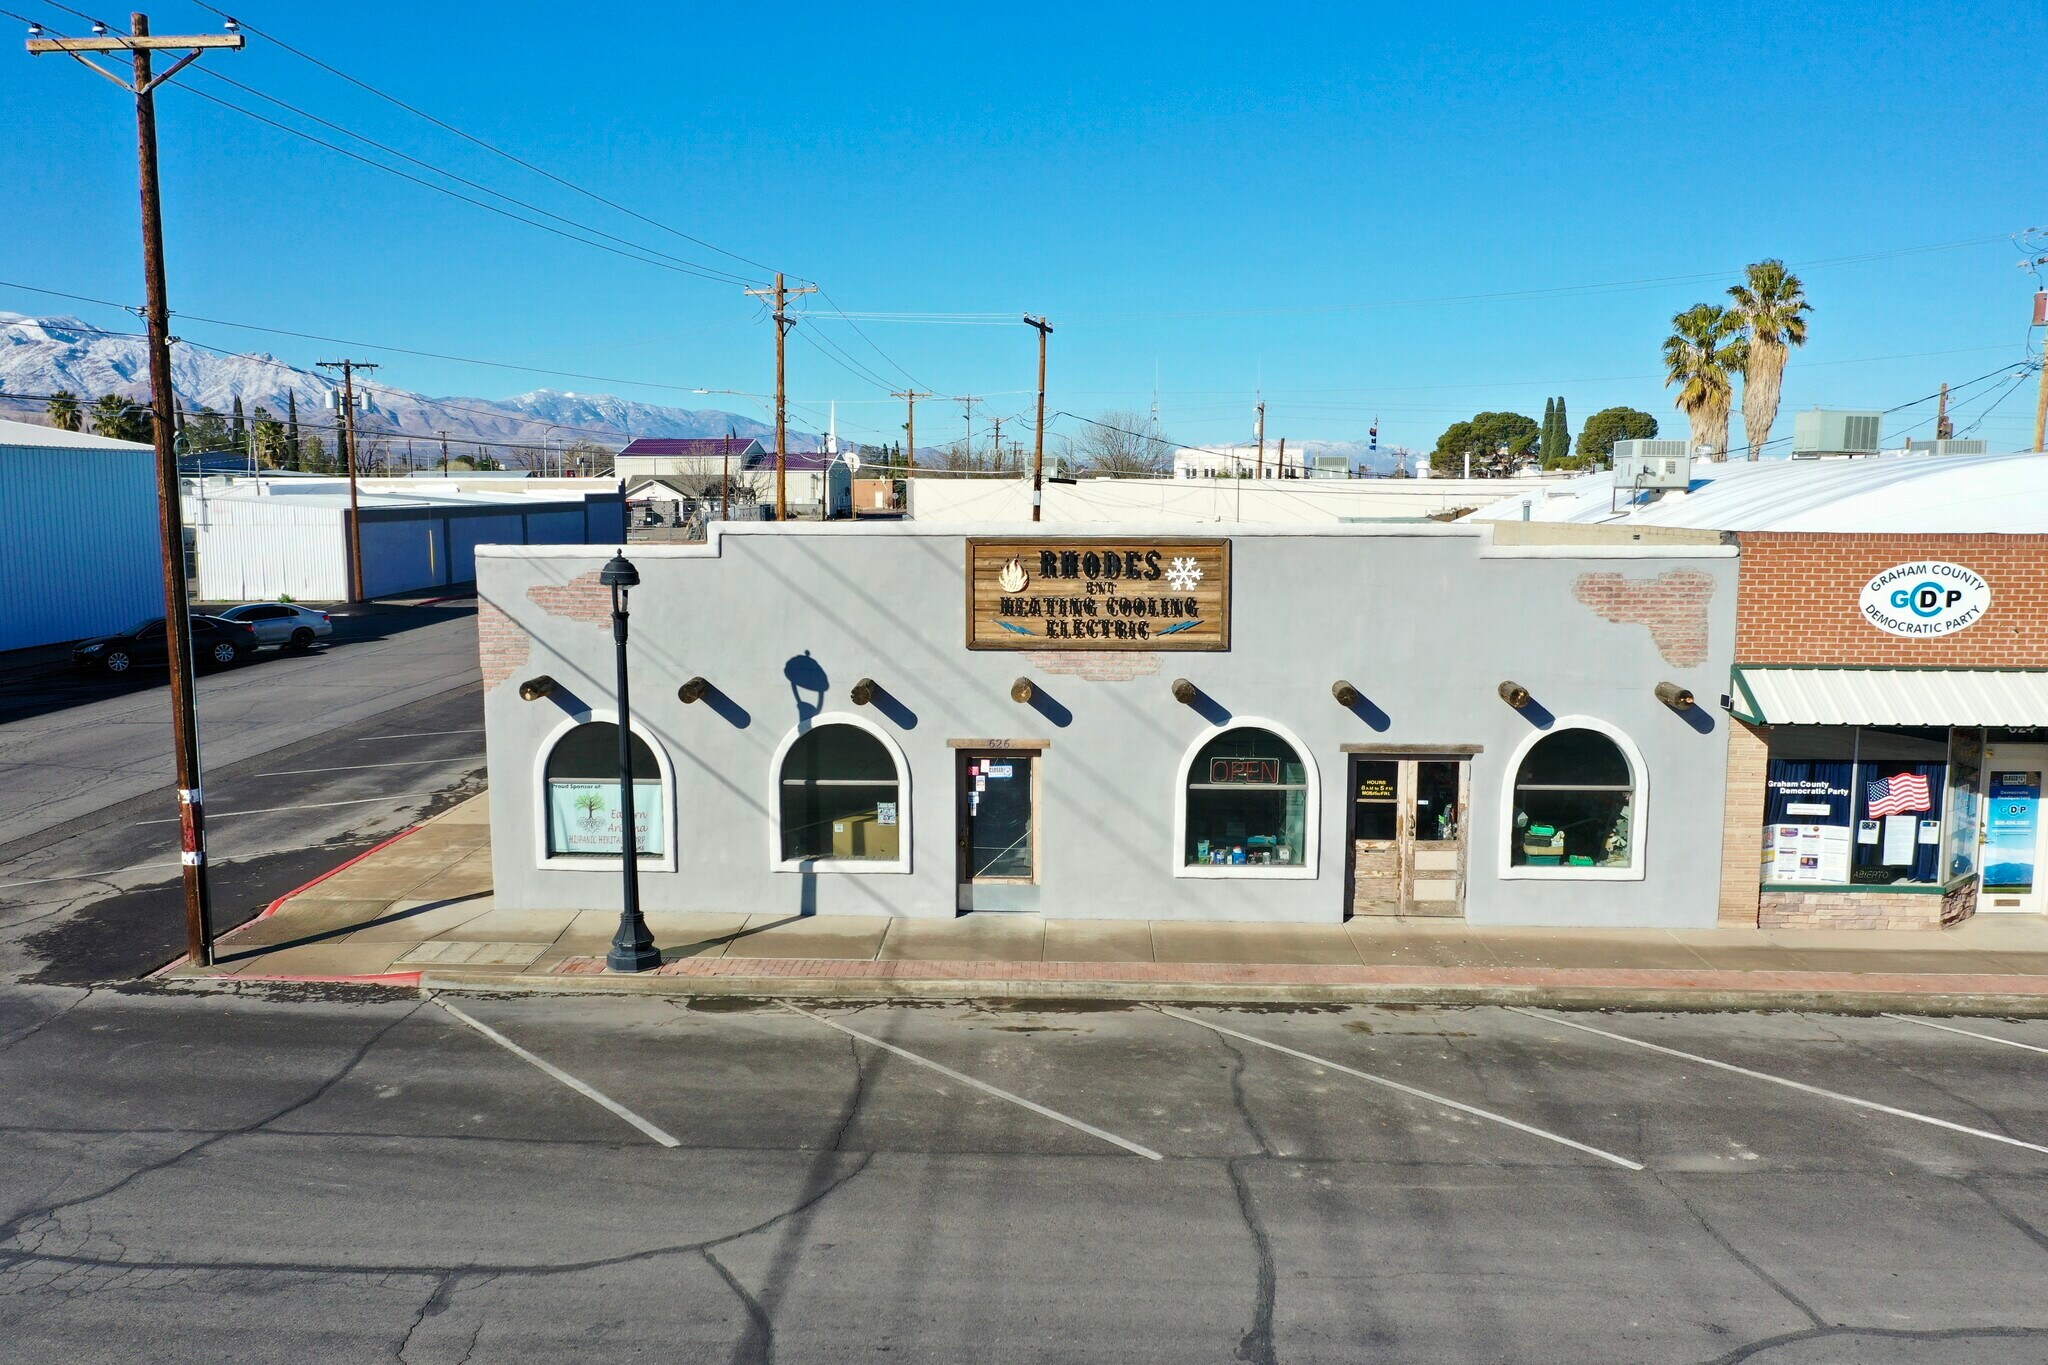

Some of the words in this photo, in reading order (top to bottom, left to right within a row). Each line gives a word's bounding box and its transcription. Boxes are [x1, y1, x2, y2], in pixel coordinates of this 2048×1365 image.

[1038, 549, 1162, 581] RHODES
[1871, 564, 1927, 592] GRAHAM
[1931, 564, 1985, 592] COUNTY
[999, 596, 1098, 618] HEATING
[1105, 596, 1199, 618] COOLING
[1865, 604, 1943, 634] DEMOCRATIC
[1945, 604, 1981, 631] PARTY
[1045, 619, 1151, 641] ELECTRIC
[988, 739, 1011, 749] 626
[1212, 760, 1277, 783] OPEN
[1768, 780, 1799, 788] Graham
[1800, 780, 1829, 789] County
[1827, 788, 1849, 796] Party
[610, 809, 649, 819] Earn
[607, 823, 649, 833] Arina
[568, 834, 597, 844] HISPANIC
[598, 835, 623, 844] HERITA
[1853, 869, 1889, 880] ABIERTO
